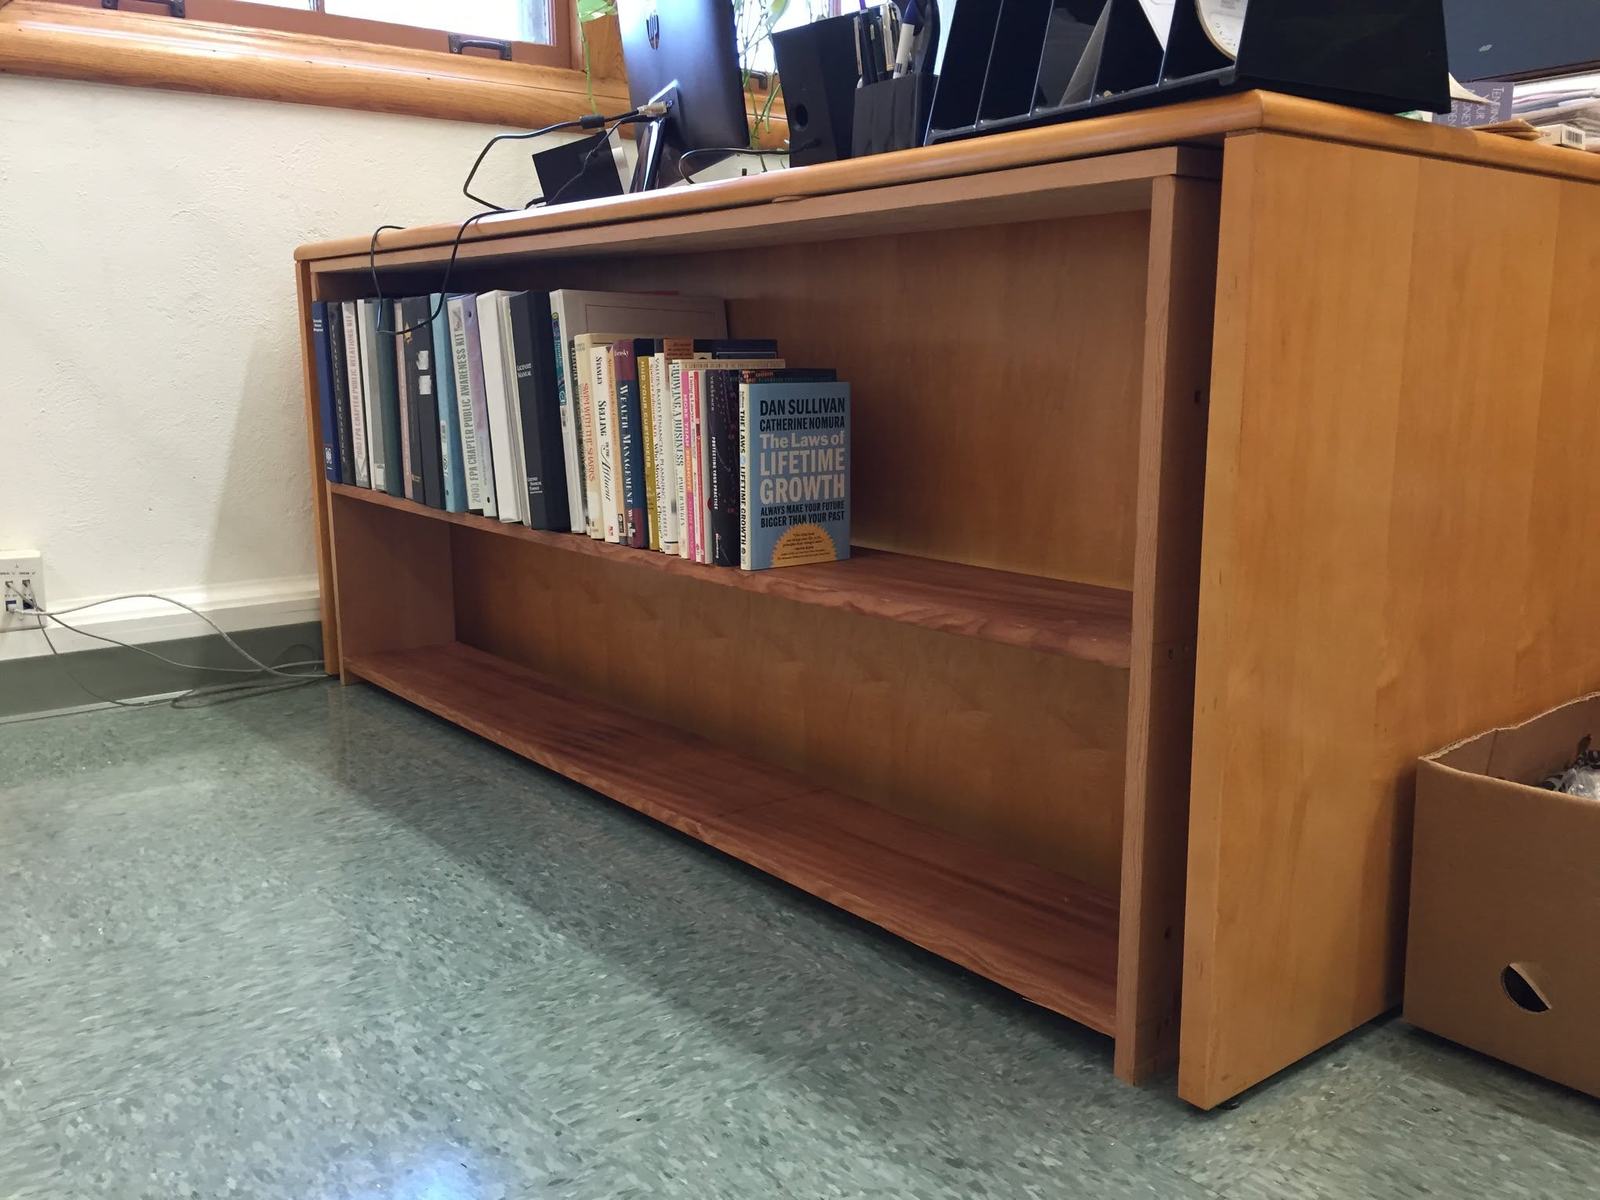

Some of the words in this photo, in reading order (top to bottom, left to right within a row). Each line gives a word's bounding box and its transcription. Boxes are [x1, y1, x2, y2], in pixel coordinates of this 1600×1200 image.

[1489, 87, 1505, 126] TENING
[454, 333, 465, 347] KIT
[456, 348, 471, 396] AWARENESS
[595, 356, 603, 385] STANLEY
[582, 383, 590, 405] SWIM
[620, 385, 629, 429] WEALTH
[760, 399, 785, 416] DAN
[788, 397, 845, 415] SULLIVAN
[461, 399, 474, 428] PUBLIC
[584, 406, 592, 427] WITH
[598, 400, 607, 437] SELLING
[760, 417, 808, 432] CATHERINE
[809, 415, 845, 430] NOMURA
[465, 428, 477, 464] CHAPTER
[643, 413, 651, 468] CUSTOMERS
[674, 418, 683, 466] BUSINESS
[760, 433, 788, 449] The
[791, 432, 829, 448] Laws
[830, 430, 844, 446] of
[587, 447, 595, 482] SHARKS
[601, 449, 611, 502] Affluent
[622, 434, 633, 503] MANAGEMENT
[760, 448, 845, 476] LIFETIME
[760, 473, 845, 505] GROWTH
[760, 505, 785, 517] ALWAYS
[786, 503, 804, 515] MAKE
[804, 502, 821, 513] YOUR
[822, 500, 845, 511] FUTURE
[760, 516, 787, 528] BIGGER
[788, 514, 807, 526] THAN
[808, 512, 827, 523] YOUR
[828, 511, 845, 521] PAST
